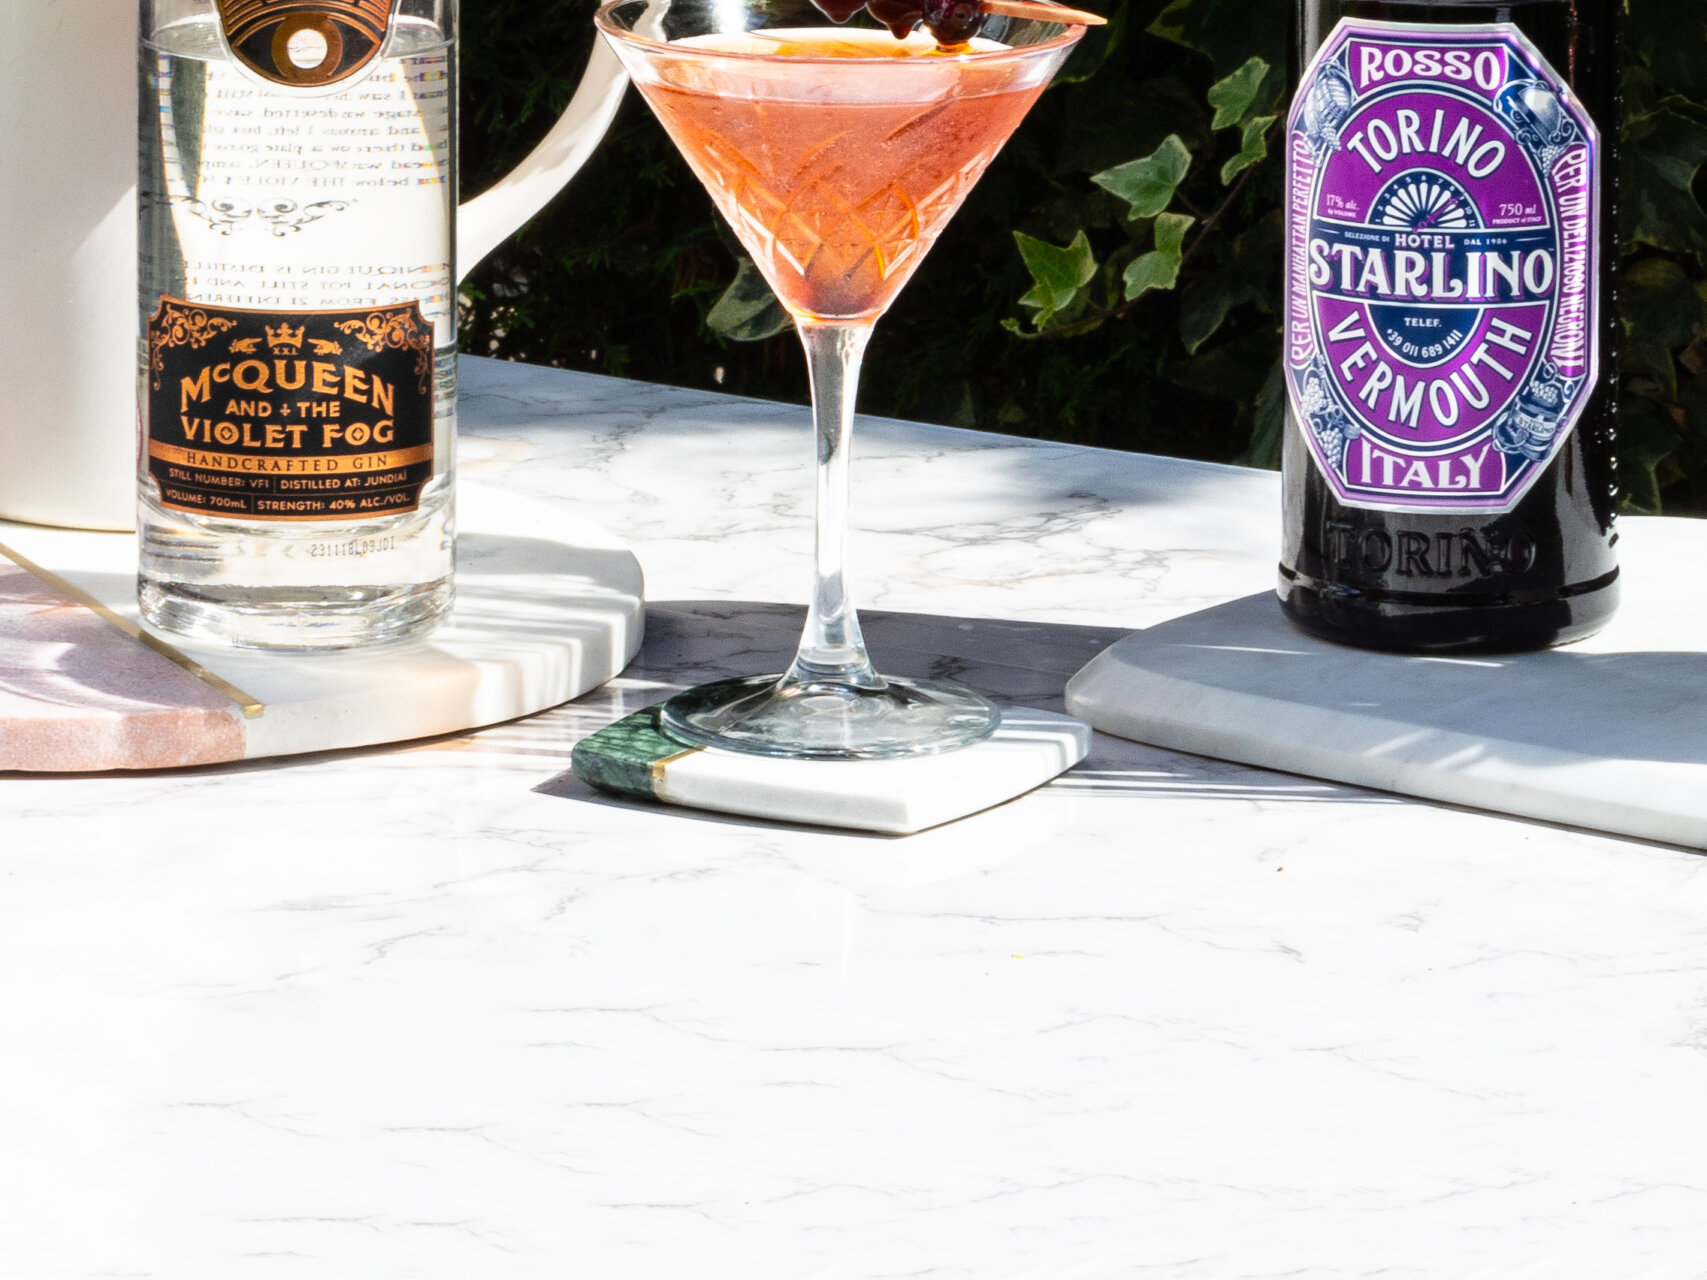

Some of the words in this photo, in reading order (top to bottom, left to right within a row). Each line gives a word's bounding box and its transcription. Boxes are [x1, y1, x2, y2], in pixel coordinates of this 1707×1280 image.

[1360, 46, 1500, 90] ROSSO
[1346, 109, 1506, 178] TORINO
[1292, 139, 1315, 217] PERFETTO
[1552, 148, 1586, 193] PER
[1326, 193, 1344, 208] 17%
[1499, 203, 1523, 216] 750
[1525, 204, 1537, 214] ml
[1559, 191, 1586, 218] UN
[1291, 210, 1307, 296] MANHATTAN
[1395, 233, 1455, 249] HOTEL
[1562, 217, 1586, 293] DELIZIOSO
[1309, 238, 1554, 298] STARLINO
[1291, 295, 1309, 319] UN
[1404, 317, 1442, 327] TELEF.
[1291, 319, 1314, 361] PER
[1402, 342, 1419, 357] 011
[1421, 343, 1443, 358] 689
[1442, 329, 1463, 350] 1411
[1550, 293, 1585, 367] NEGRONI
[1328, 311, 1532, 428] VERMOUTH
[225, 399, 272, 417] AND
[297, 401, 341, 418] THE
[180, 415, 309, 449] VIOLET
[322, 419, 395, 449] FOG
[168, 468, 192, 480] STILL
[195, 472, 246, 487] NUMBER:
[280, 478, 341, 489] DISTILLED
[344, 477, 361, 488] AT:
[187, 452, 339, 471] HANDCRAFTED
[353, 455, 388, 470] GIN
[1361, 436, 1492, 489] ITALY
[165, 488, 206, 504] VOLUME:
[209, 496, 247, 509] 700mL
[257, 500, 325, 511] STRENGTH:
[329, 500, 356, 510] 40%
[1326, 521, 1537, 578] TORINO
